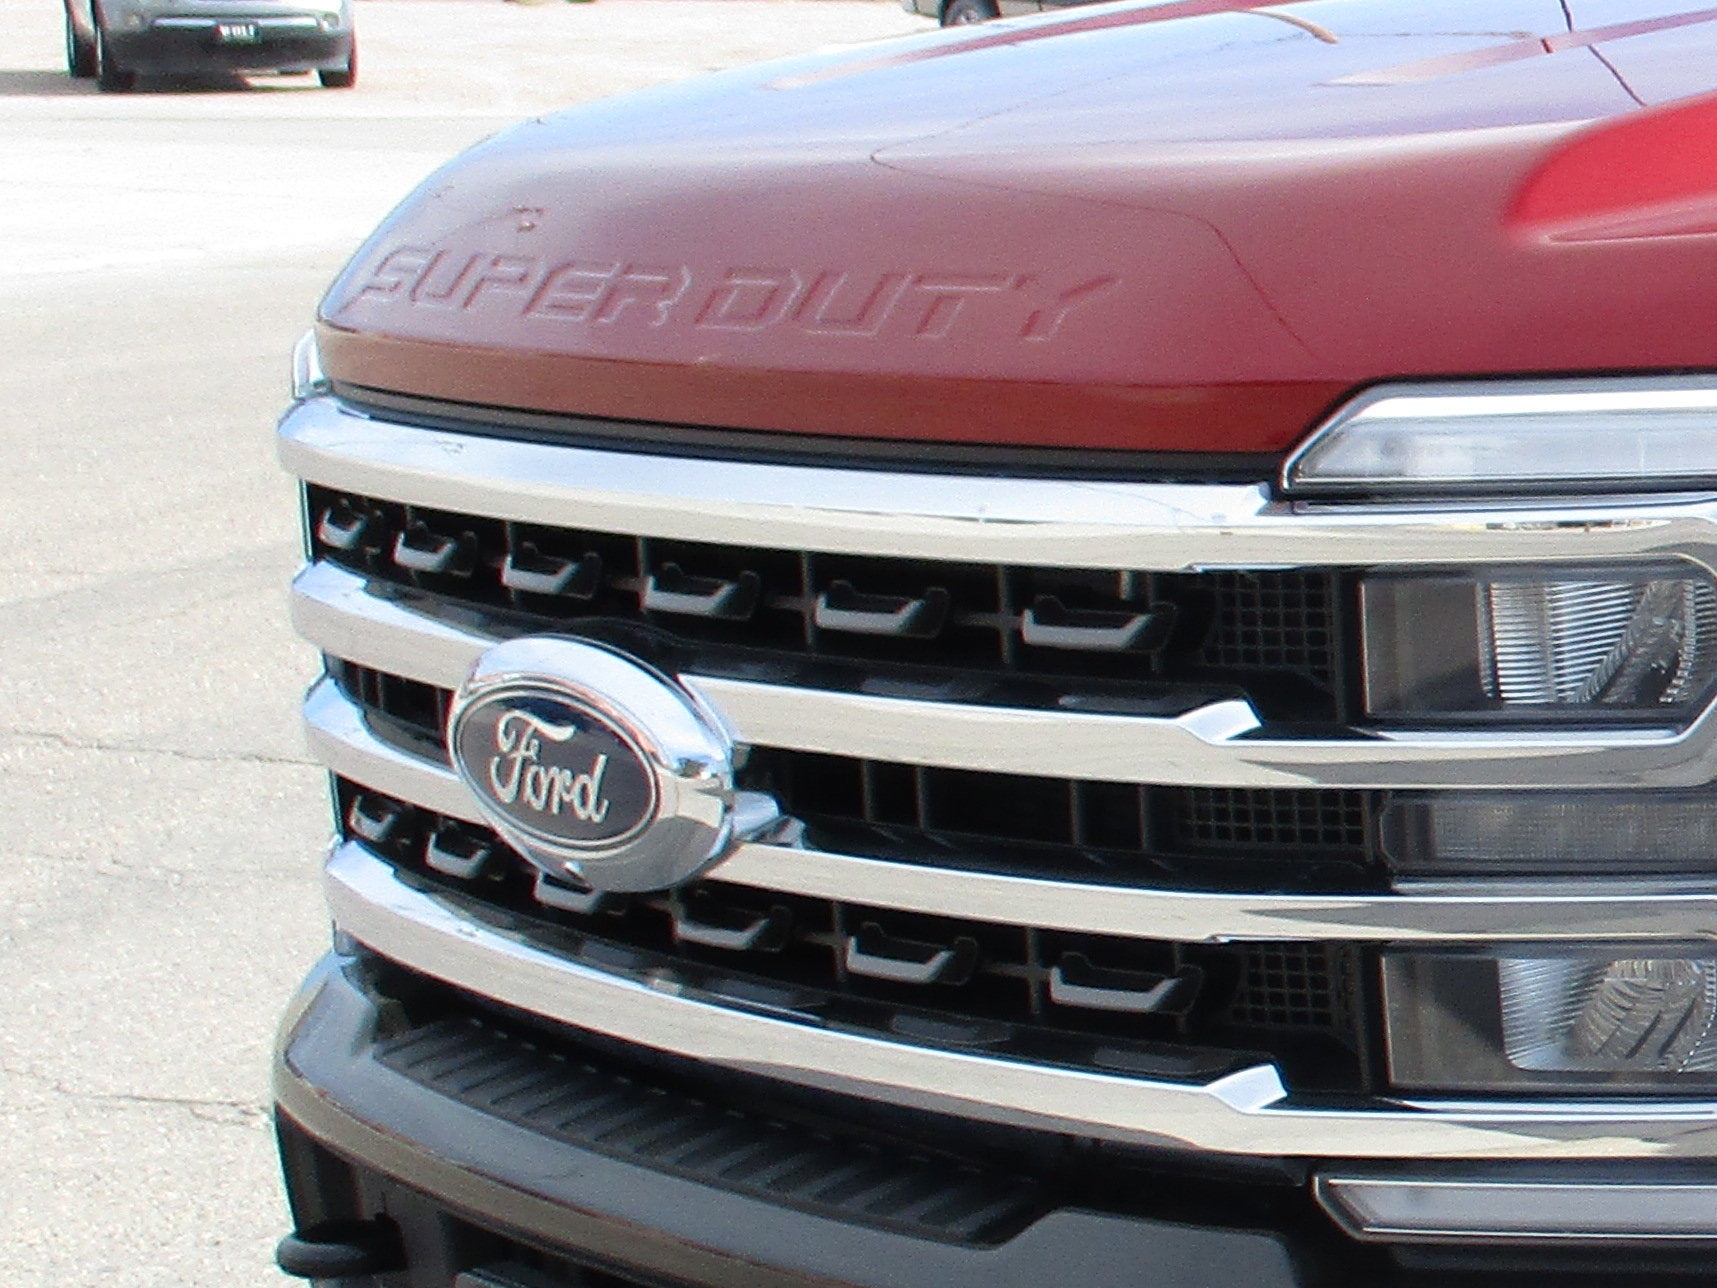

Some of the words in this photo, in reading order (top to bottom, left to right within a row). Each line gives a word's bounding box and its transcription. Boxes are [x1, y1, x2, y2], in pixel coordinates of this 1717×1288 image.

[344, 243, 692, 327] SUPER
[694, 264, 1122, 343] DUTY
[489, 708, 613, 825] Ford
